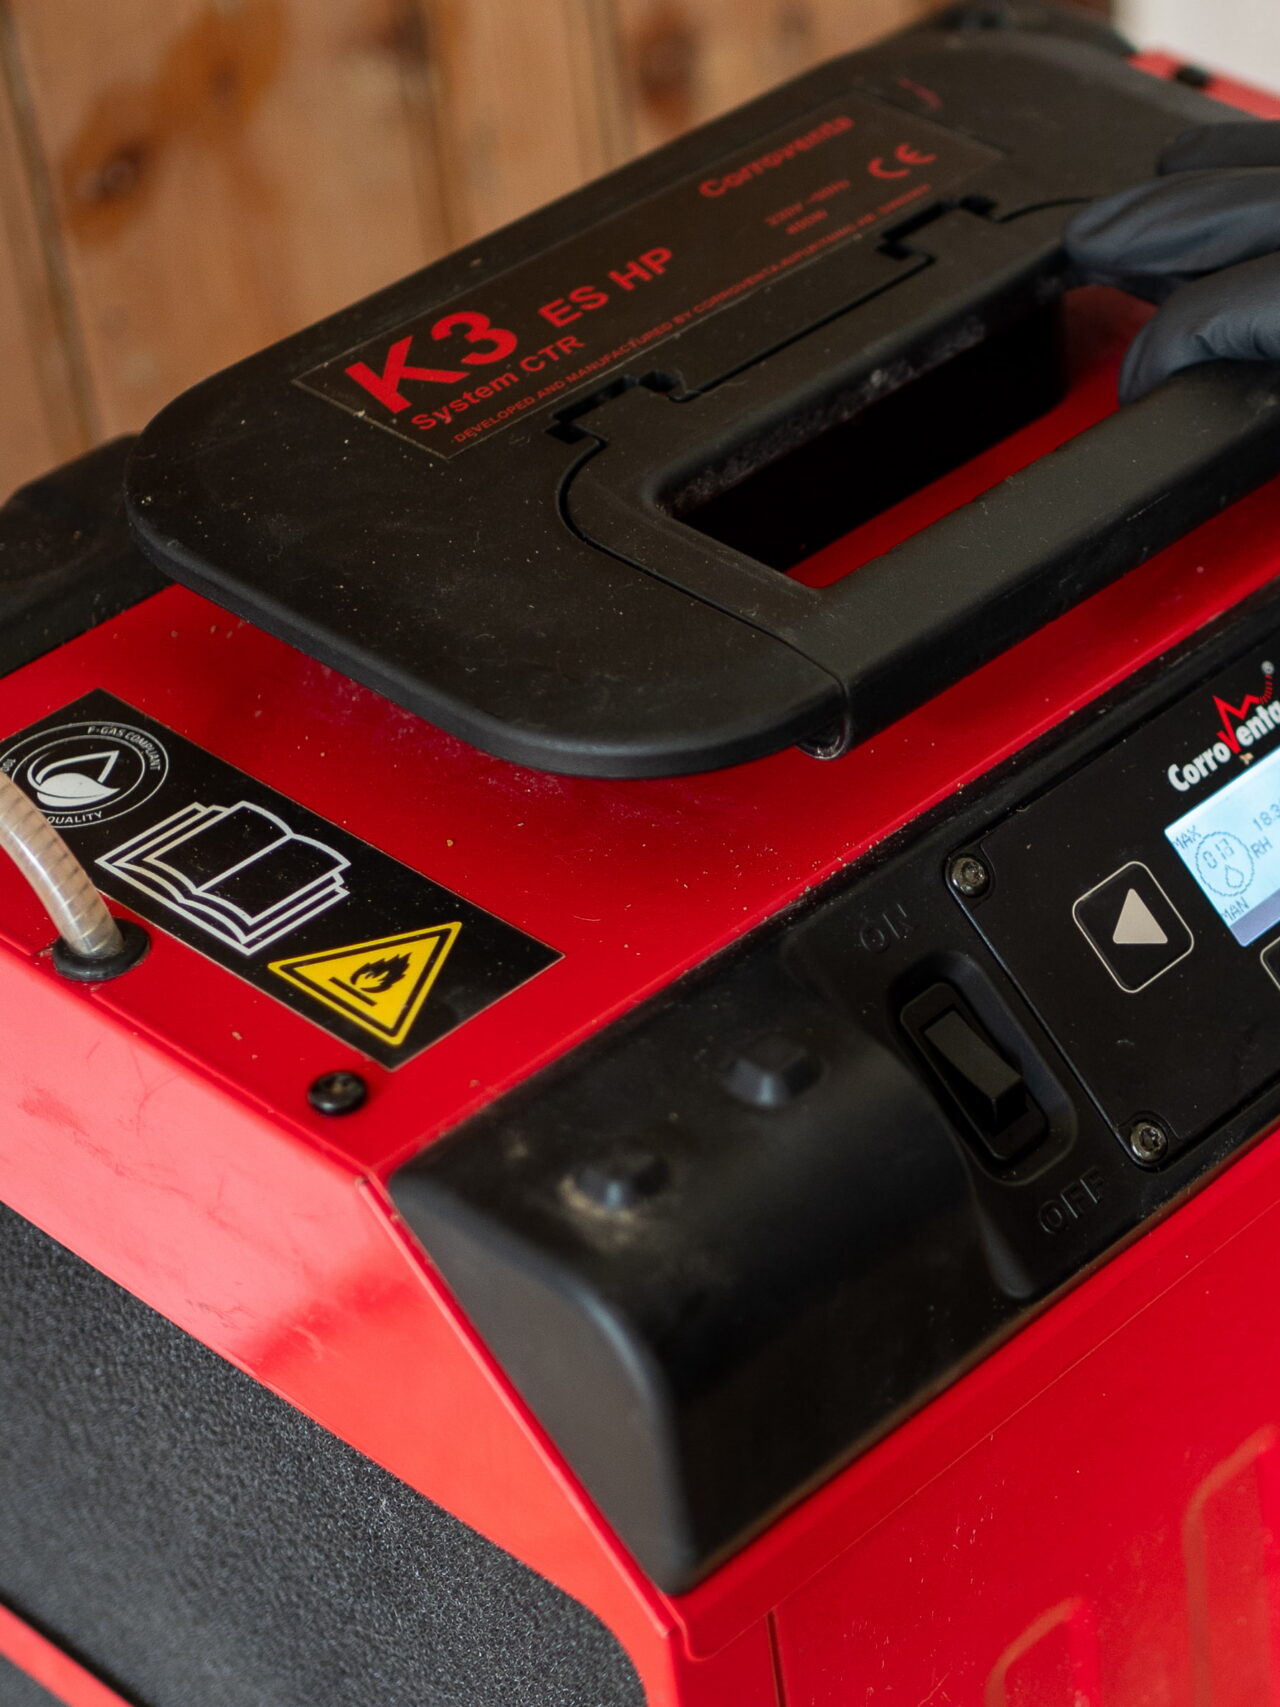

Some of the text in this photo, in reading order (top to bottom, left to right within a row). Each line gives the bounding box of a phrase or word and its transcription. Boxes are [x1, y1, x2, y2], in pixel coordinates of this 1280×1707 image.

[344, 247, 673, 414] K3 ES HP
[410, 335, 585, 430] System CTR
[453, 396, 536, 443] DEVELOPED
[536, 379, 566, 399] AND
[565, 321, 674, 382] MANUFACTURED
[671, 309, 693, 325] BY
[87, 725, 161, 771] F-GAS COMPLIANT
[47, 810, 103, 825] QUALITY
[1250, 837, 1273, 859] RH
[1037, 1165, 1106, 1235] OFF
